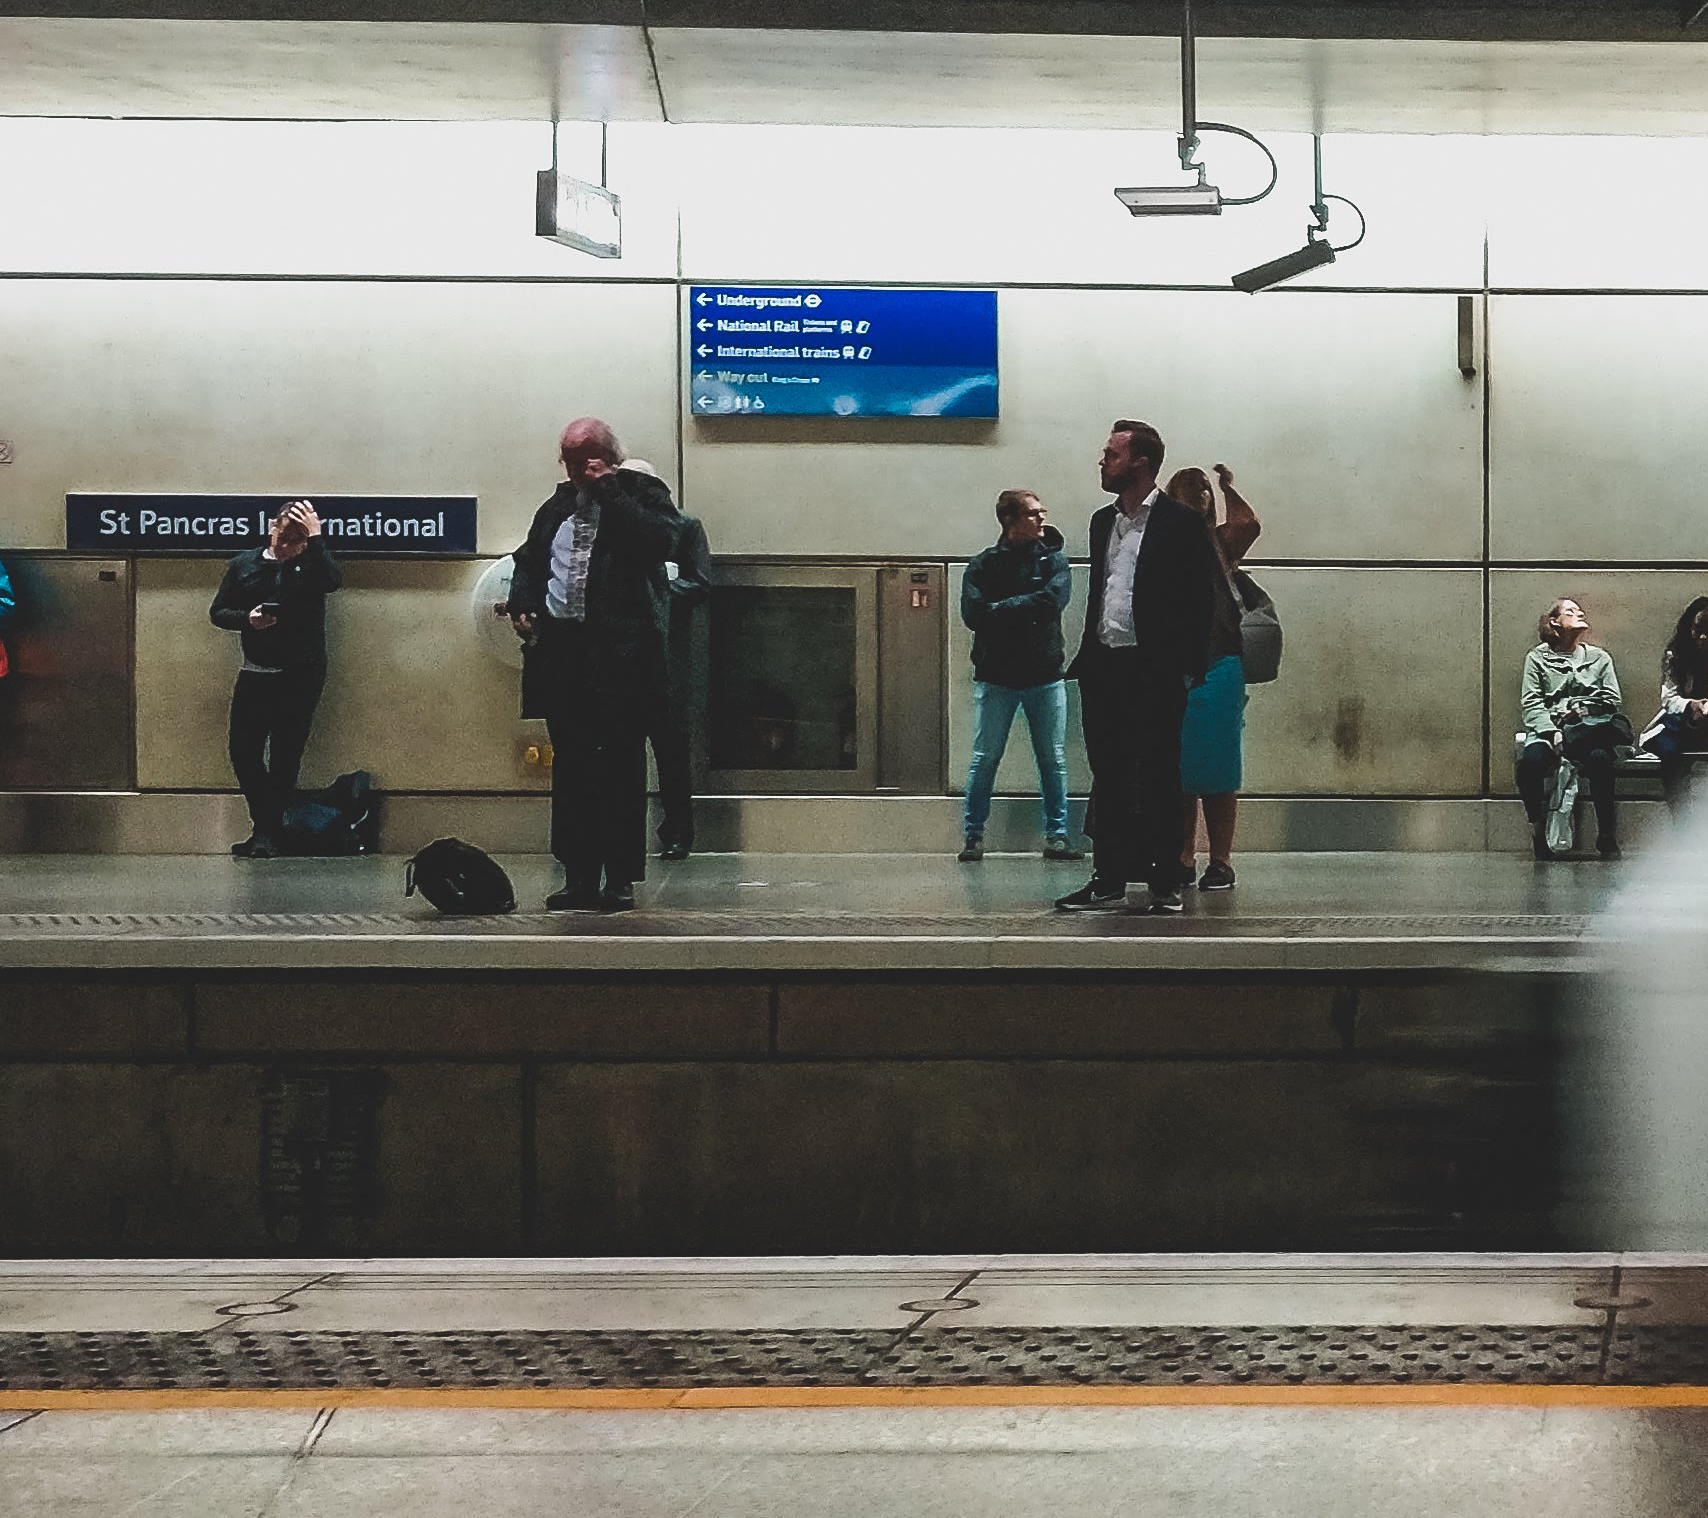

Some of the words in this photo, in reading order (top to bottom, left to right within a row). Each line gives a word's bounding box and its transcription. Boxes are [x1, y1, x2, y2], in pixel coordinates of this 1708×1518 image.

[716, 294, 802, 309] Underground
[717, 319, 772, 332] National
[773, 320, 800, 333] Rail
[717, 345, 800, 358] International
[802, 346, 840, 359] trains
[717, 370, 746, 385] Way
[747, 373, 768, 383] out
[99, 509, 131, 535] St
[140, 509, 250, 535] Pancras
